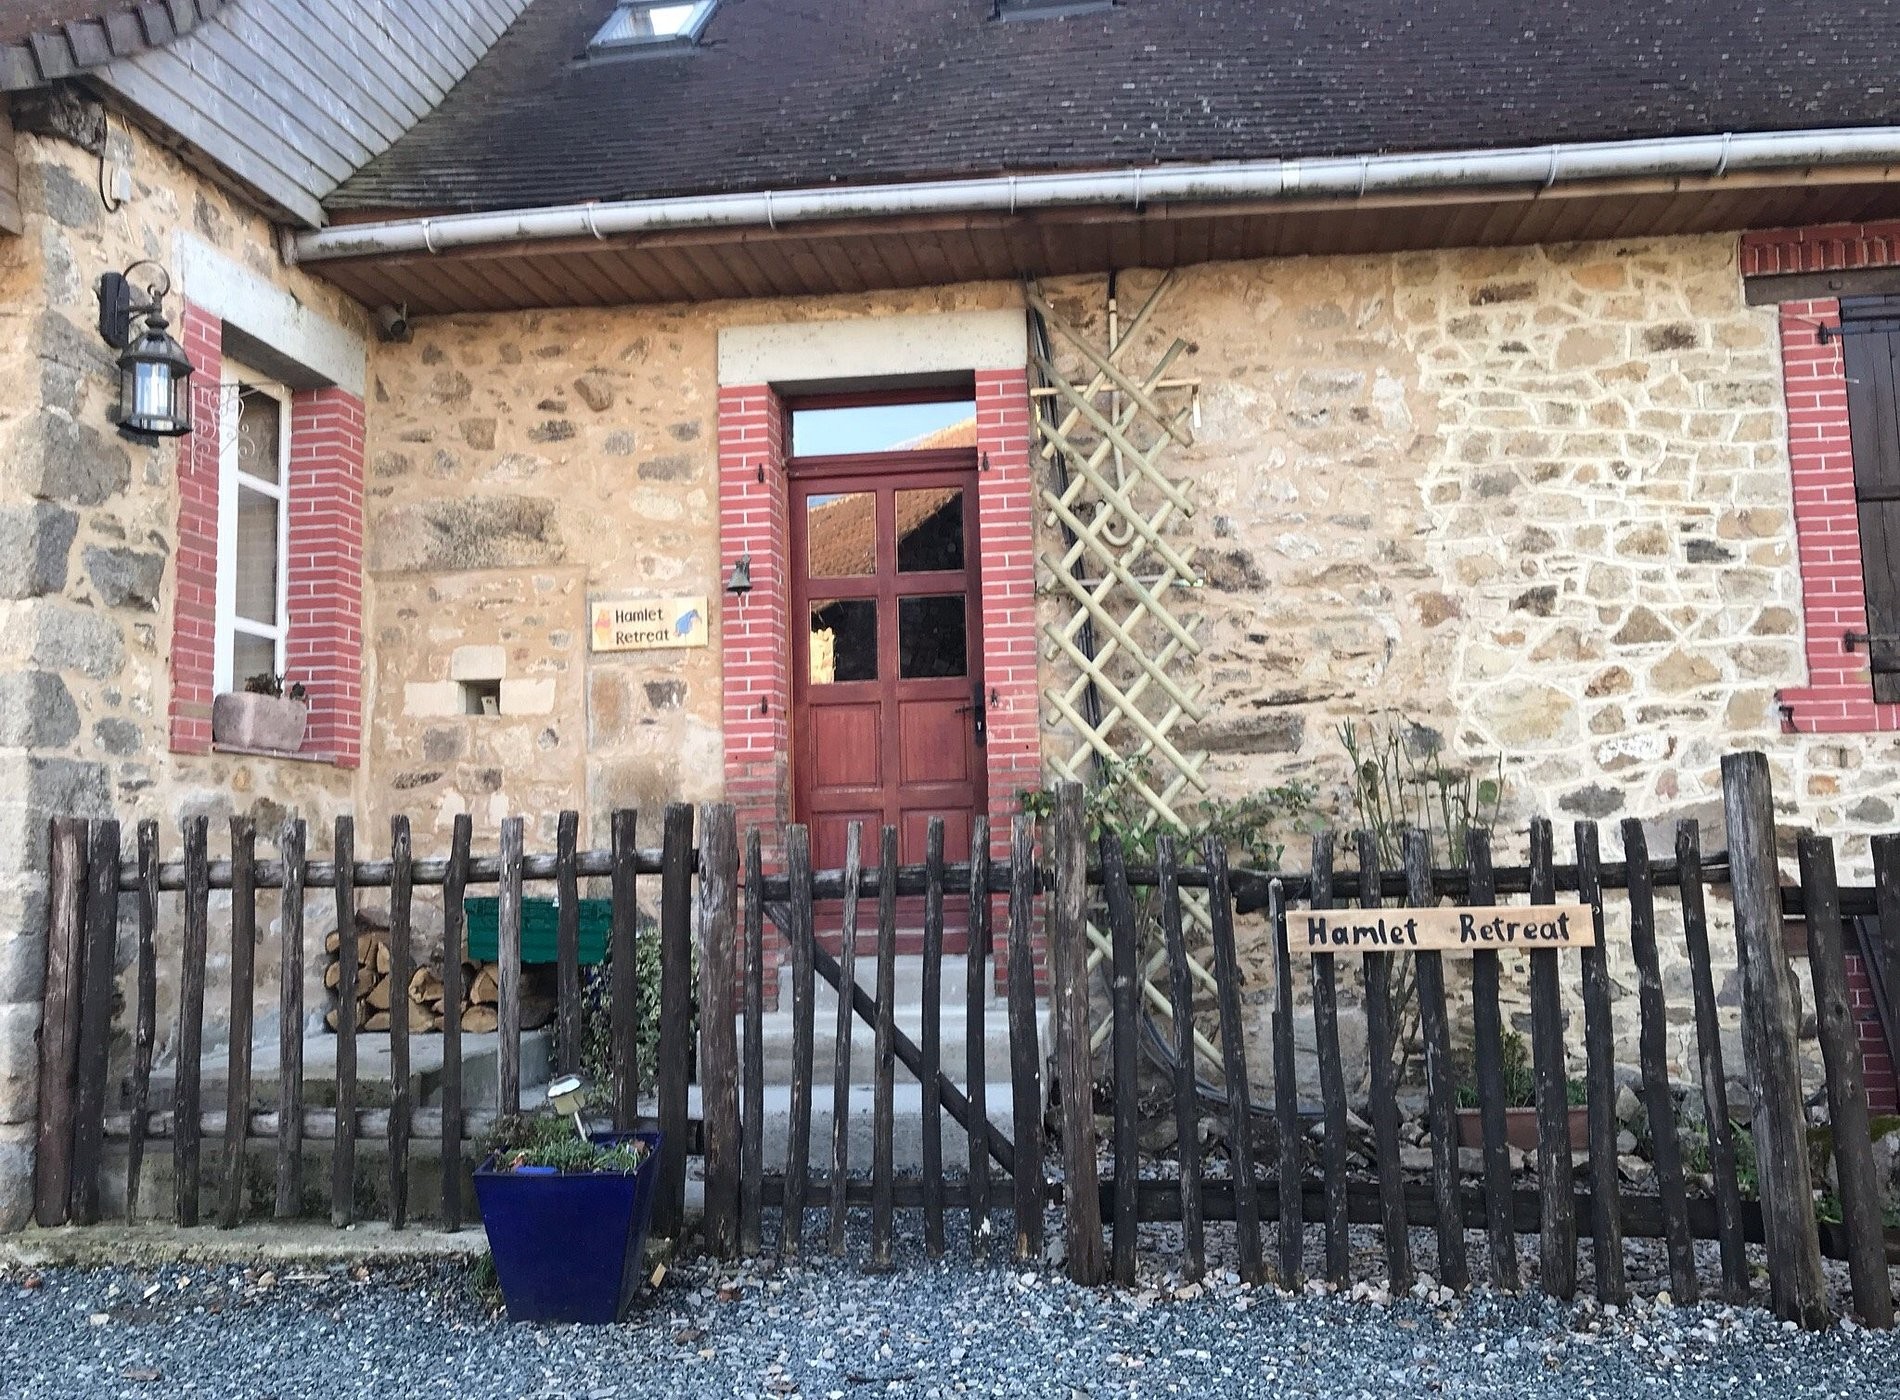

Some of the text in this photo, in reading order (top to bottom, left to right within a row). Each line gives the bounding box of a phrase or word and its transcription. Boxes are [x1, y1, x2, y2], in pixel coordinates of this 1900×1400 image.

[615, 608, 663, 623] Hamlet
[615, 628, 669, 645] Retreat
[1307, 912, 1570, 945] Hamlet Retreat
